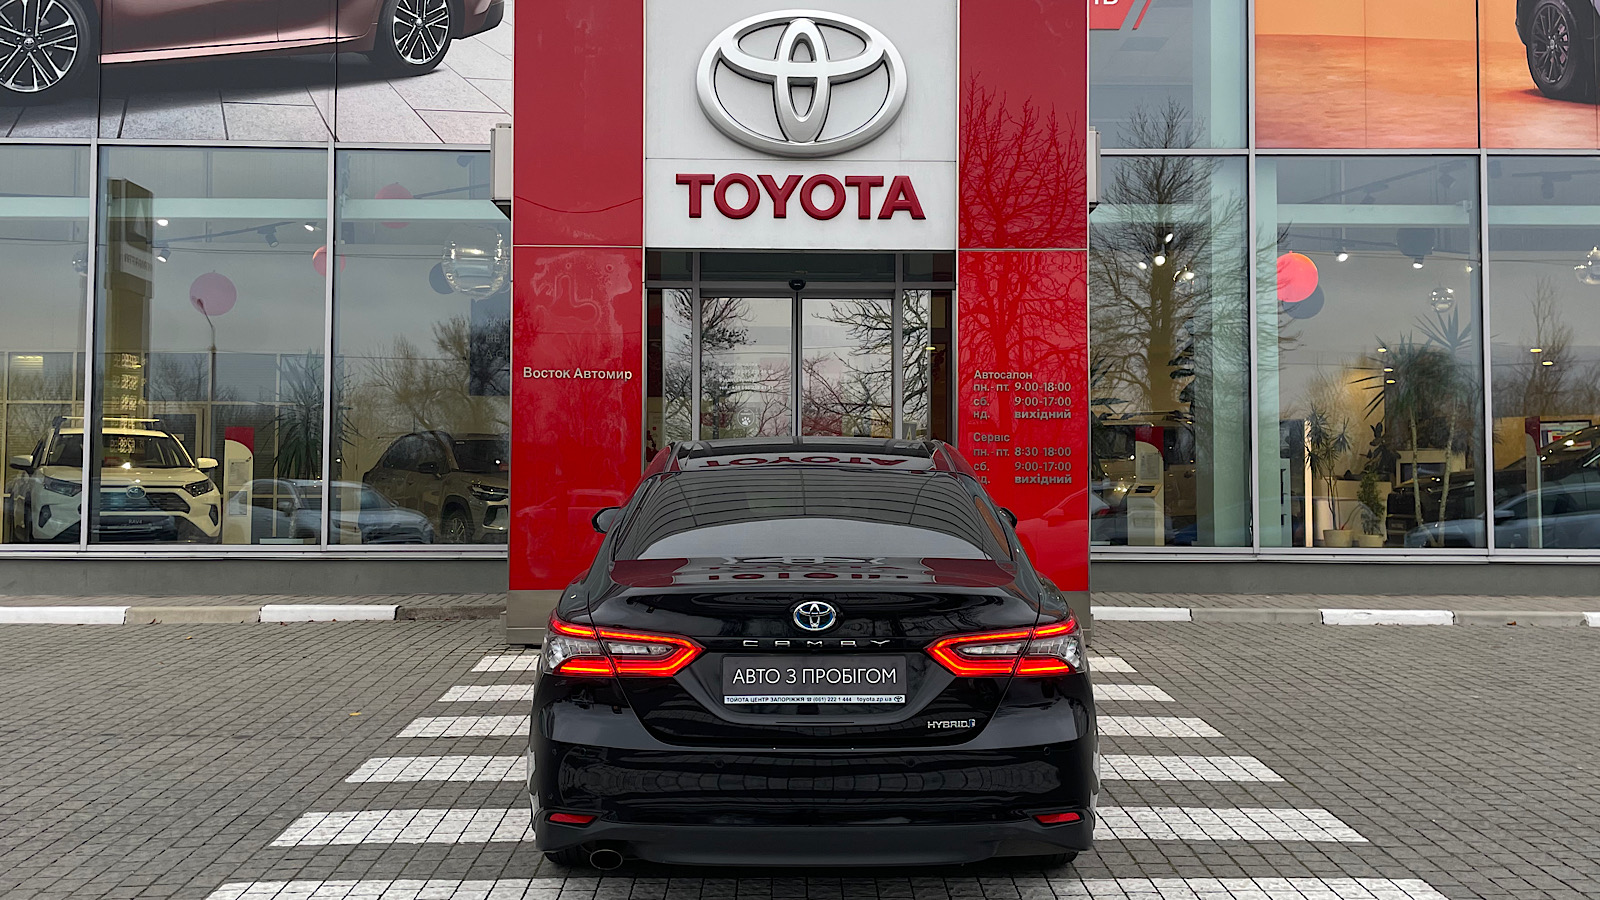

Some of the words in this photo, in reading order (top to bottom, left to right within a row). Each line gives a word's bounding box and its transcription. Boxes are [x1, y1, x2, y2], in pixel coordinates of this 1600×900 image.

[676, 172, 926, 220] TOYOTA
[524, 366, 570, 378] Восток
[574, 368, 632, 382] Автомир
[974, 370, 1033, 380] Автосалон
[973, 397, 990, 406] сб.
[1014, 397, 1072, 406] 9:00-17:00
[973, 411, 990, 420] нд.
[1014, 409, 1072, 420] вихідний
[973, 432, 1010, 444] Сервіс
[973, 462, 990, 471] сб.
[1014, 462, 1072, 471] 9:00-17:00
[1014, 474, 1072, 485] вихідний
[732, 668, 781, 684] АВТО
[802, 668, 897, 684] ПРОБІГОМ
[927, 720, 970, 728] HYBRID
